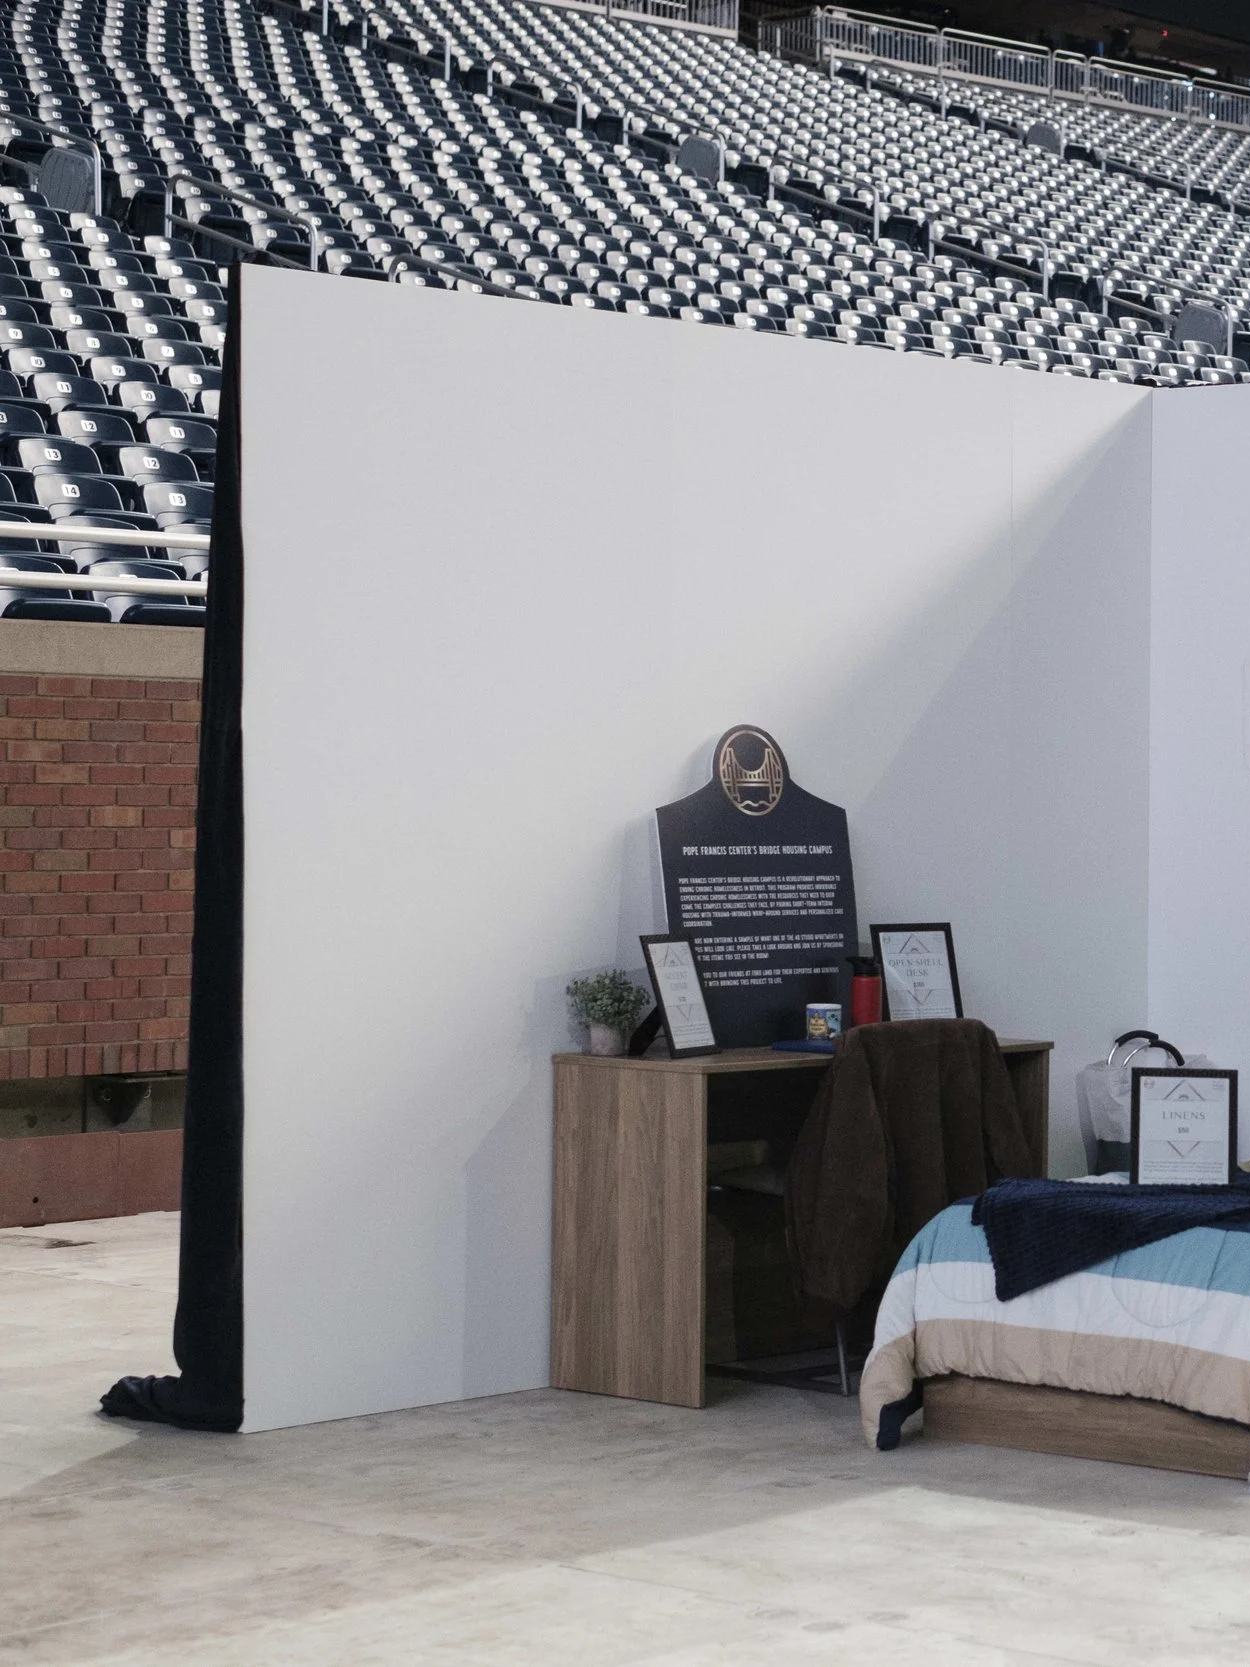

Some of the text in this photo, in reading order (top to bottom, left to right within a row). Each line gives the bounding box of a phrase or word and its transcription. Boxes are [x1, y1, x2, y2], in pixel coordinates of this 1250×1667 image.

[34, 358, 43, 366] 10
[60, 383, 70, 392] 11
[144, 392, 153, 400] 10
[84, 422, 95, 430] 12
[173, 428, 182, 437] 11
[48, 450, 59, 460] 13
[146, 458, 157, 468] 12
[65, 485, 78, 496] 14
[172, 494, 184, 505] 13
[682, 845, 832, 856] POPE FRANCIS CENTER'S BRIDGE HOUSING CAMPUS
[1162, 1111, 1205, 1120] LINENS
